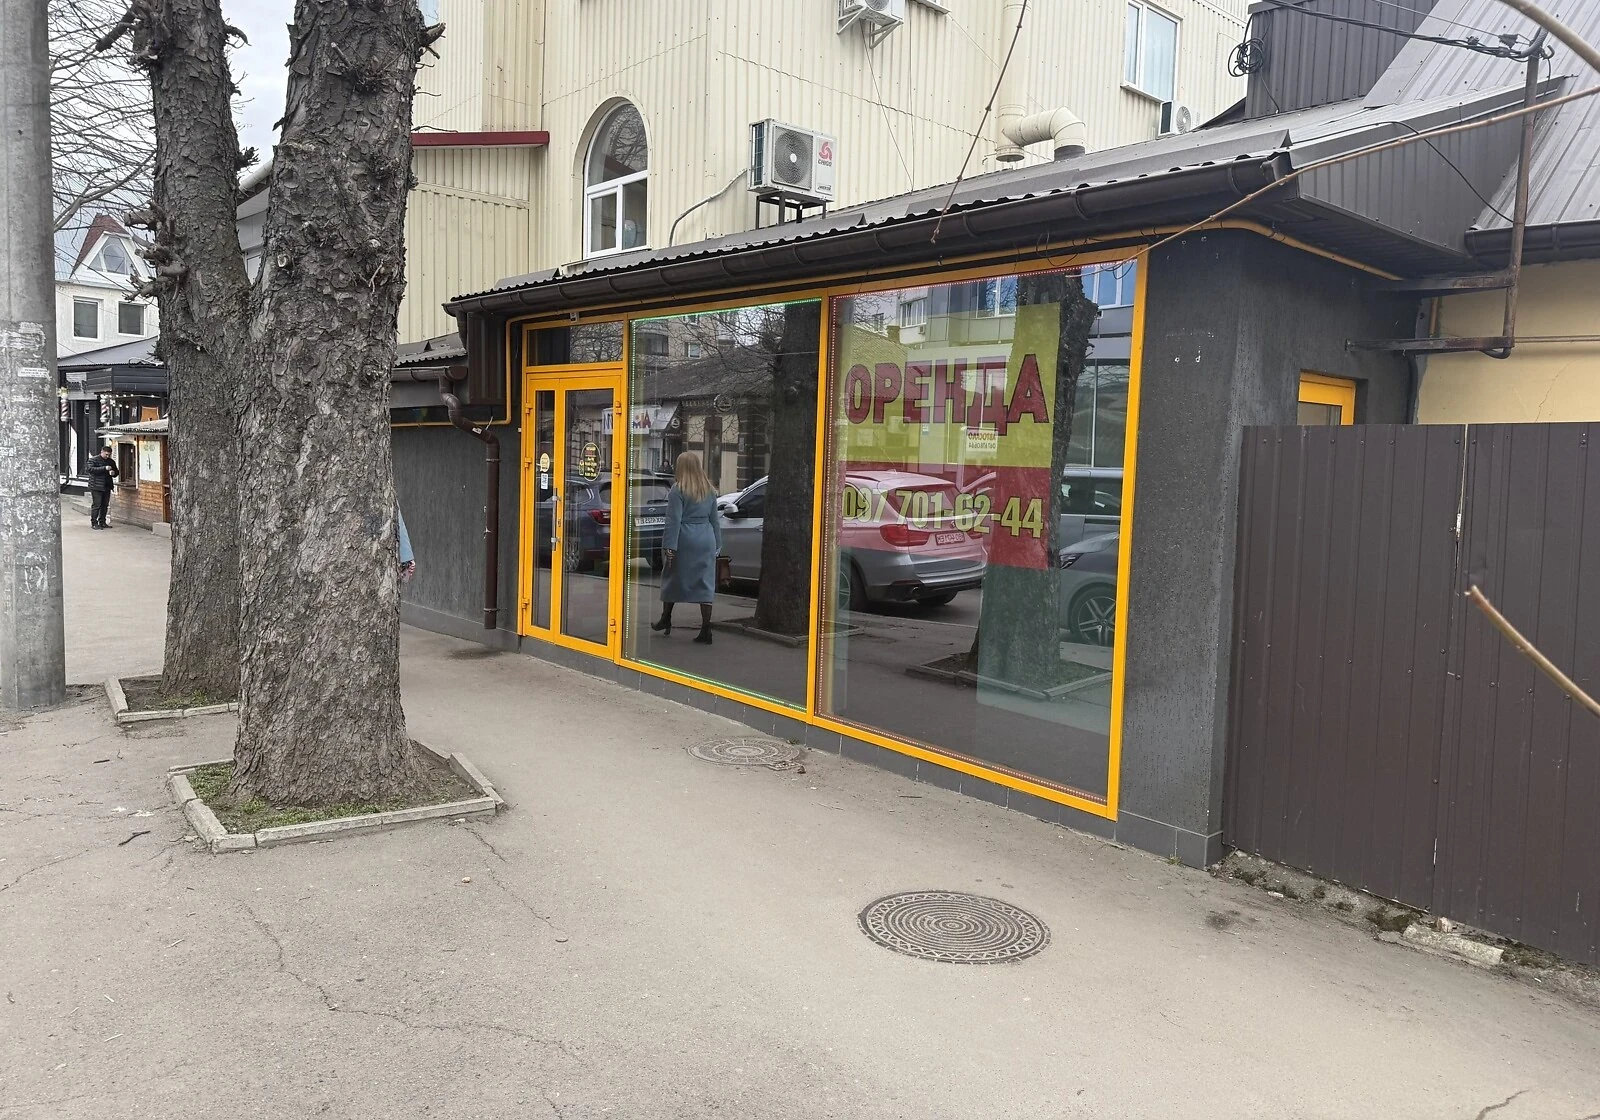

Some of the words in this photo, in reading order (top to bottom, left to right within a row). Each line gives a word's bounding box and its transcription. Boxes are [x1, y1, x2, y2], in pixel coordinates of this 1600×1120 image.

[844, 354, 1049, 436] ОРЕНДА
[842, 486, 889, 522] 097
[895, 489, 1044, 538] 701-62-44
